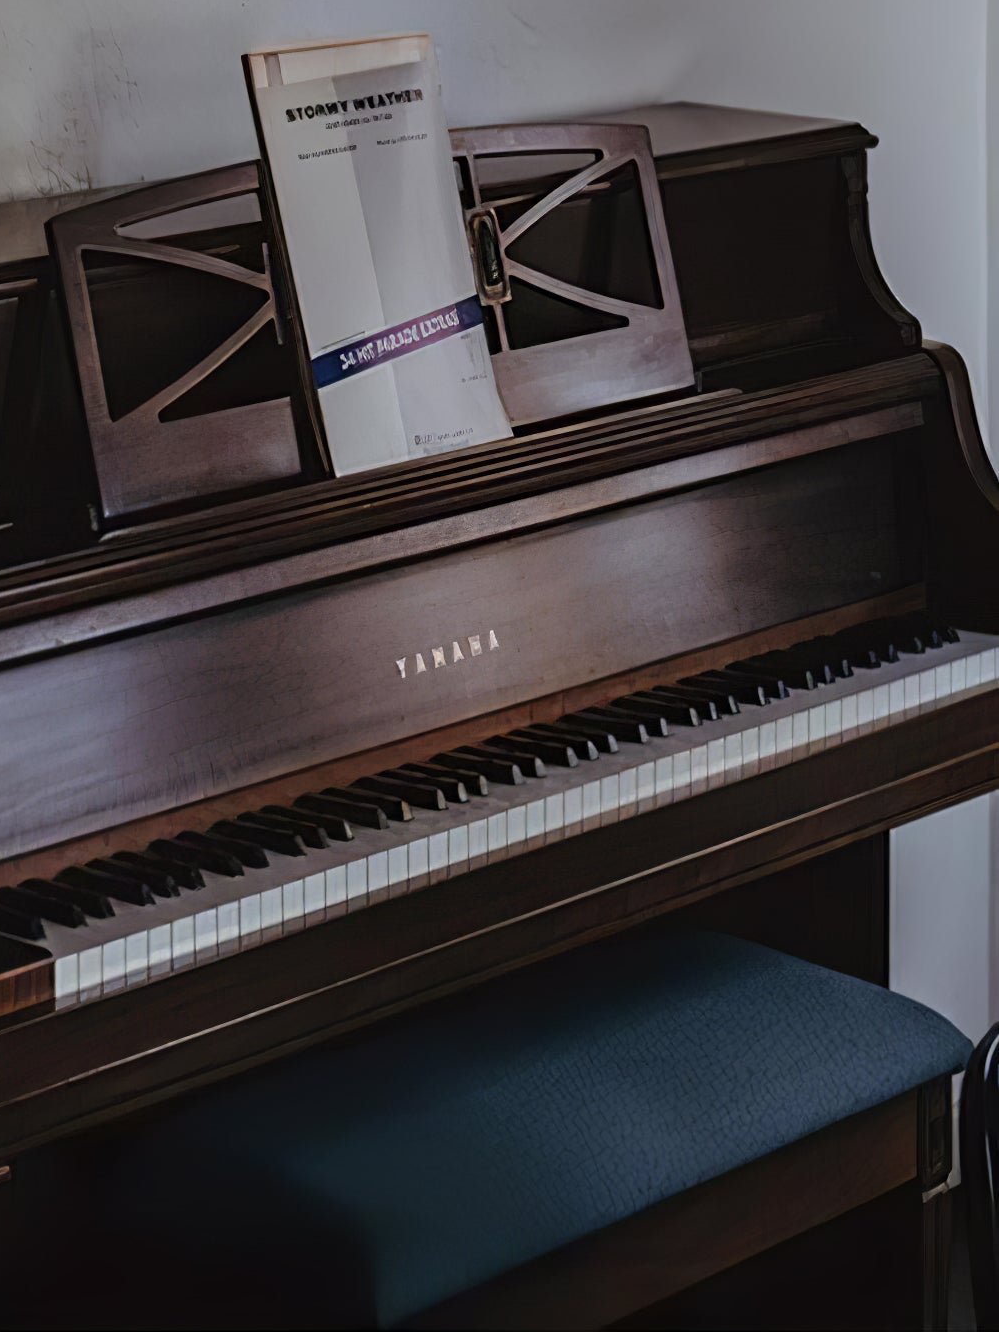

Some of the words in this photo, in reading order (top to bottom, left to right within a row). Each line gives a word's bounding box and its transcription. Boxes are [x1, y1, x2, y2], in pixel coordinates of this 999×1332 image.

[285, 100, 348, 122] STORMY
[353, 89, 424, 111] WEATHER
[396, 630, 499, 678] YAMAHA
